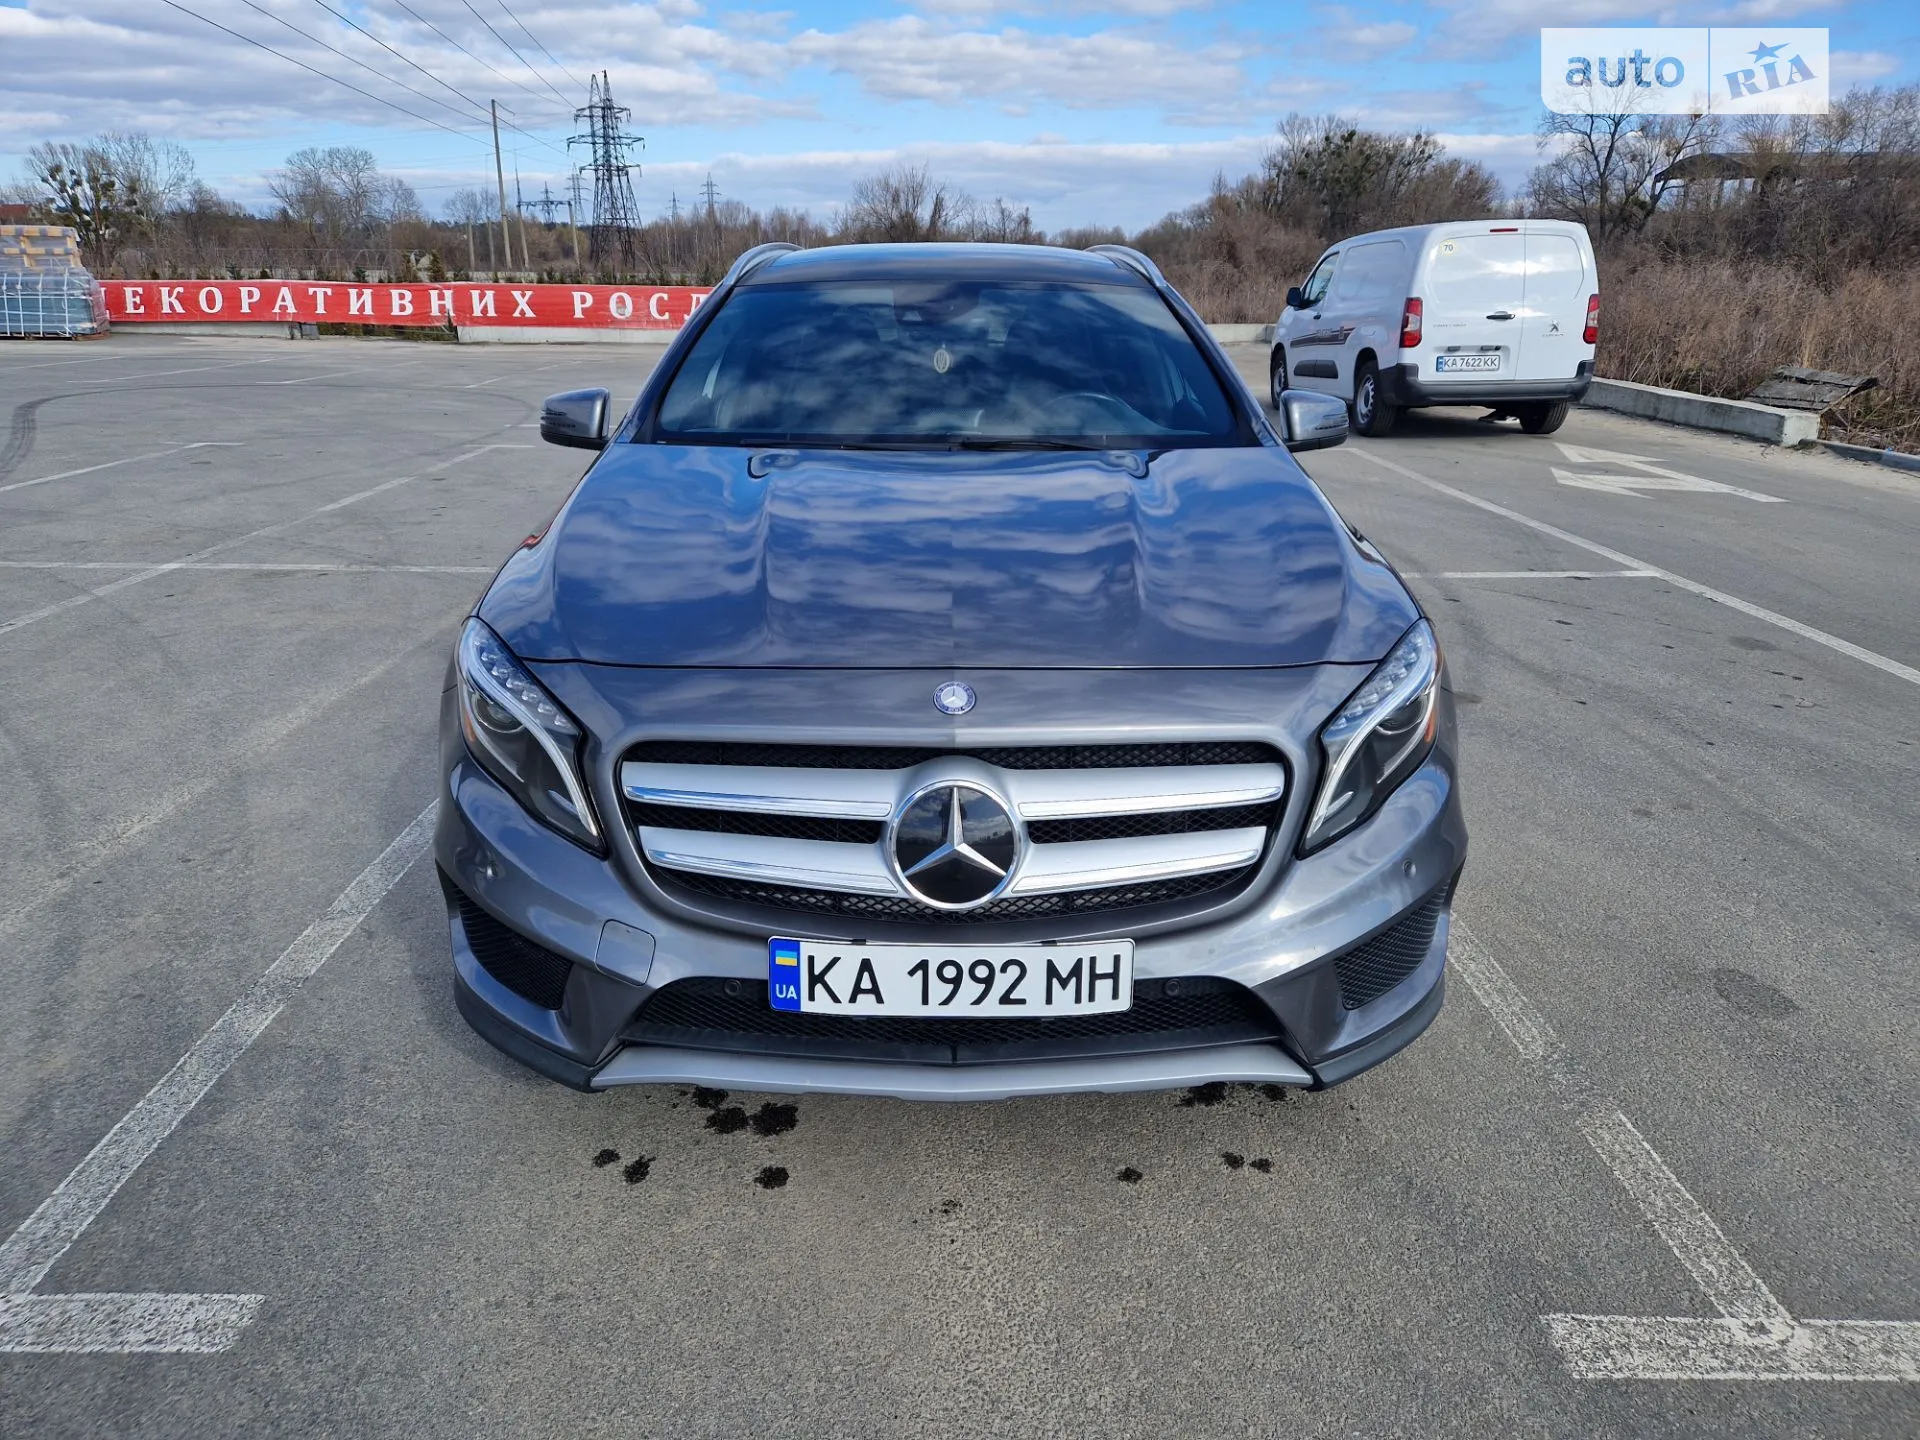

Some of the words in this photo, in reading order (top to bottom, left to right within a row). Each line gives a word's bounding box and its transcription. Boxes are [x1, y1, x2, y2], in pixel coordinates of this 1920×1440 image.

[1444, 244, 1454, 252] 70
[101, 286, 536, 319] ЕКОРАТИВНИХ
[1443, 358, 1457, 368] KA
[1460, 357, 1482, 368] 7622
[1483, 357, 1498, 368] KK
[807, 954, 884, 1005] KA
[907, 958, 1028, 1006] 1992
[1045, 954, 1121, 1005] MH
[775, 984, 798, 1000] UA
